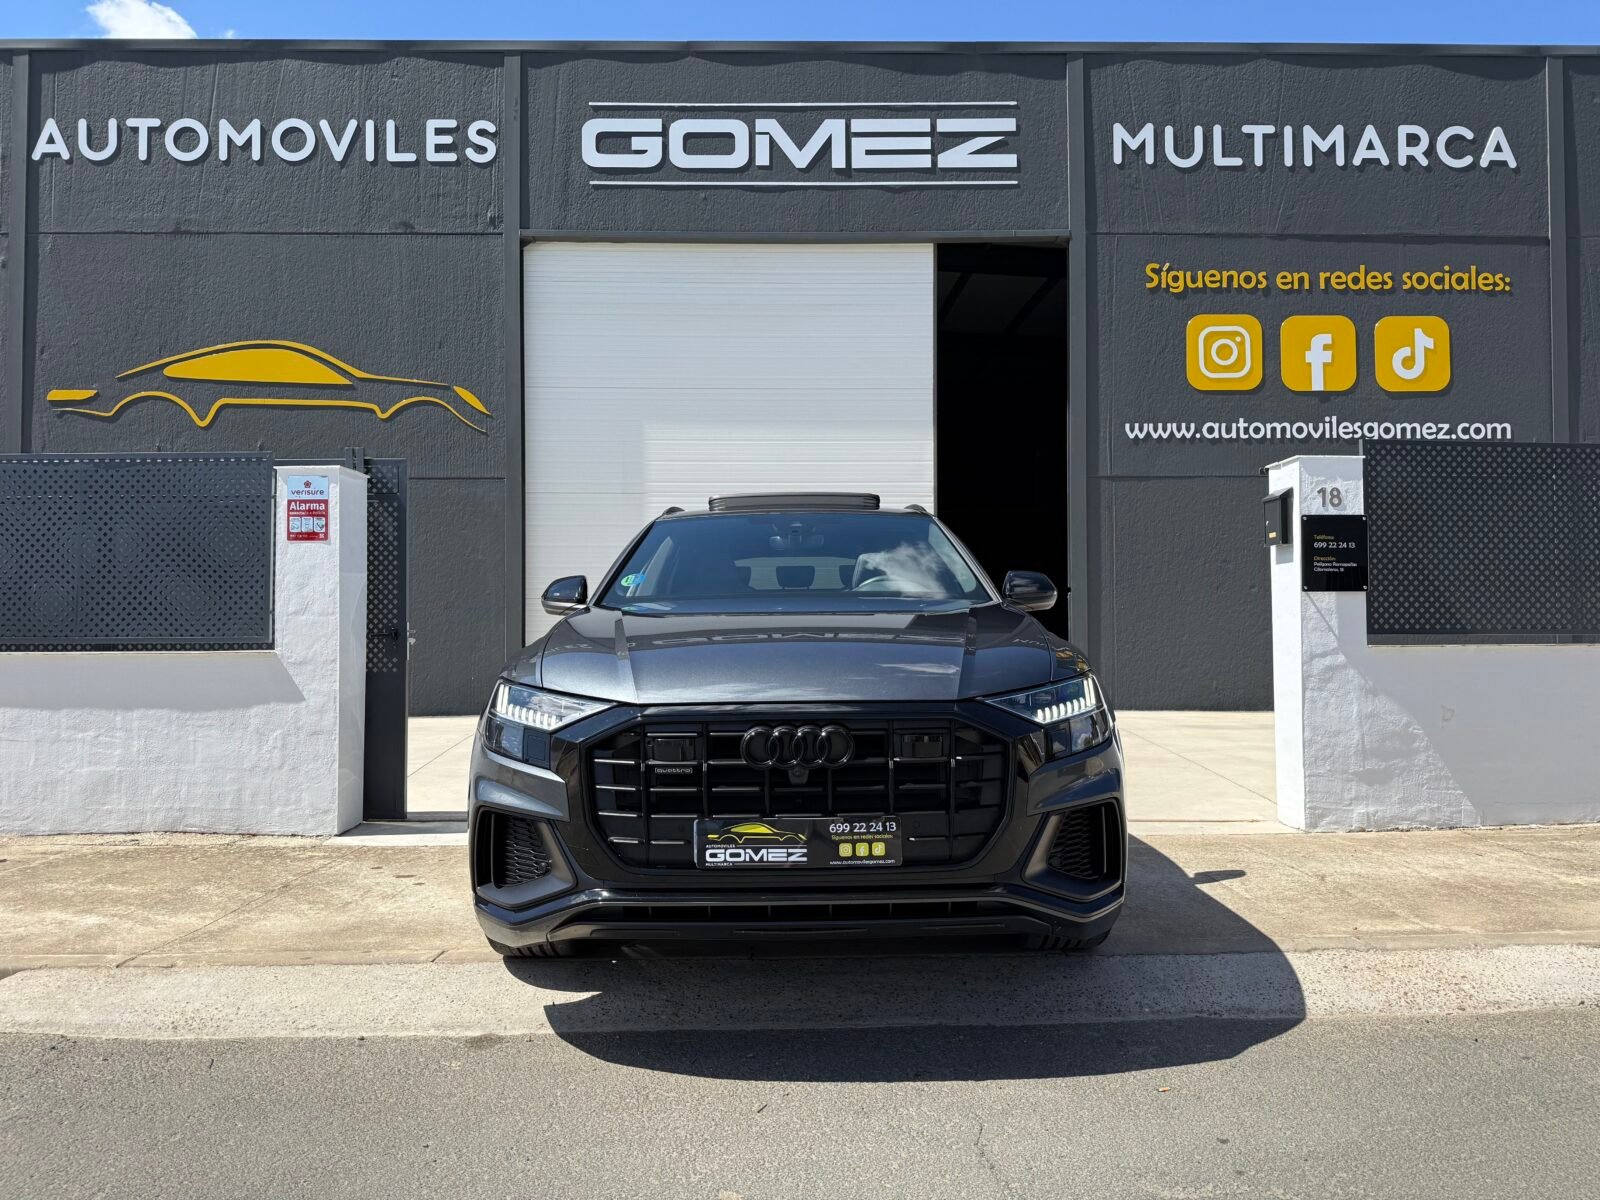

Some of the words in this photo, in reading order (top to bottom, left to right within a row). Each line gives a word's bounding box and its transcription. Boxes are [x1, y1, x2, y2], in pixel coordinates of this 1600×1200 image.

[32, 117, 498, 165] AUTOMOVILES
[581, 117, 1017, 169] GOMEZ
[1113, 123, 1518, 169] MULTIMARCA
[1145, 262, 1267, 293] Síguenos
[1276, 271, 1310, 290] en
[1319, 264, 1393, 290] redes
[1402, 265, 1511, 291] sociales:
[1124, 415, 1512, 440] www.automovilesgomez.com
[291, 488, 324, 496] verisure
[1317, 487, 1342, 508] 18
[290, 501, 325, 511] Alarma
[1313, 541, 1327, 549] 699
[1328, 541, 1338, 549] 22
[1338, 541, 1347, 549] 24
[1348, 541, 1356, 549] 13
[829, 823, 850, 833] 699
[853, 822, 867, 833] 22
[869, 822, 883, 832] 24
[886, 821, 897, 832] 13
[705, 848, 808, 862] GOMEZ
